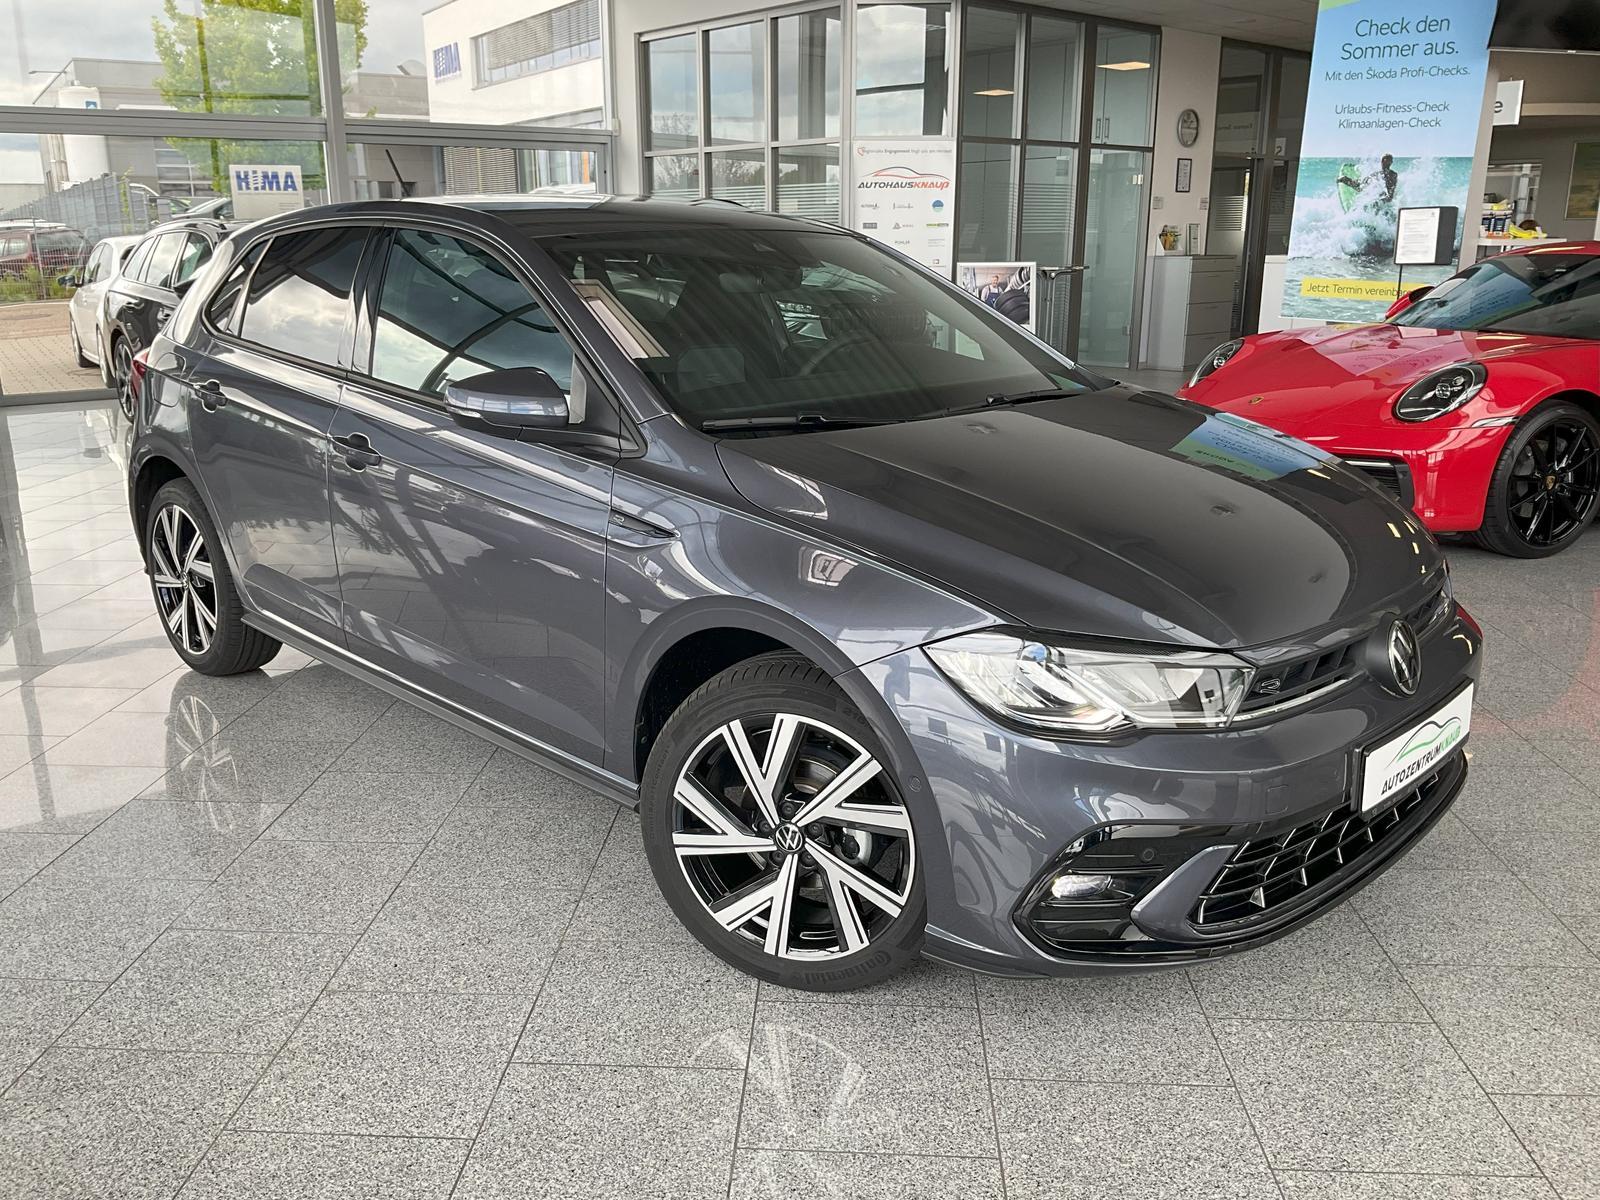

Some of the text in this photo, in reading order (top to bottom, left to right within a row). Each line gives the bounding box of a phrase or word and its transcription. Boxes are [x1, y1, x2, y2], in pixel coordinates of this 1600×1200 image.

[1355, 15, 1450, 37] Check den
[1340, 40, 1459, 60] Sommer aus.
[1325, 65, 1470, 81] Mit den Škoda Profi-Checks.
[1335, 101, 1450, 115] Urlaubs-Fitness-Check
[1338, 117, 1441, 131] Klimaanlagen-Check
[235, 170, 298, 191] HIMA
[1307, 283, 1407, 297] Jetzt Termin vereinbar
